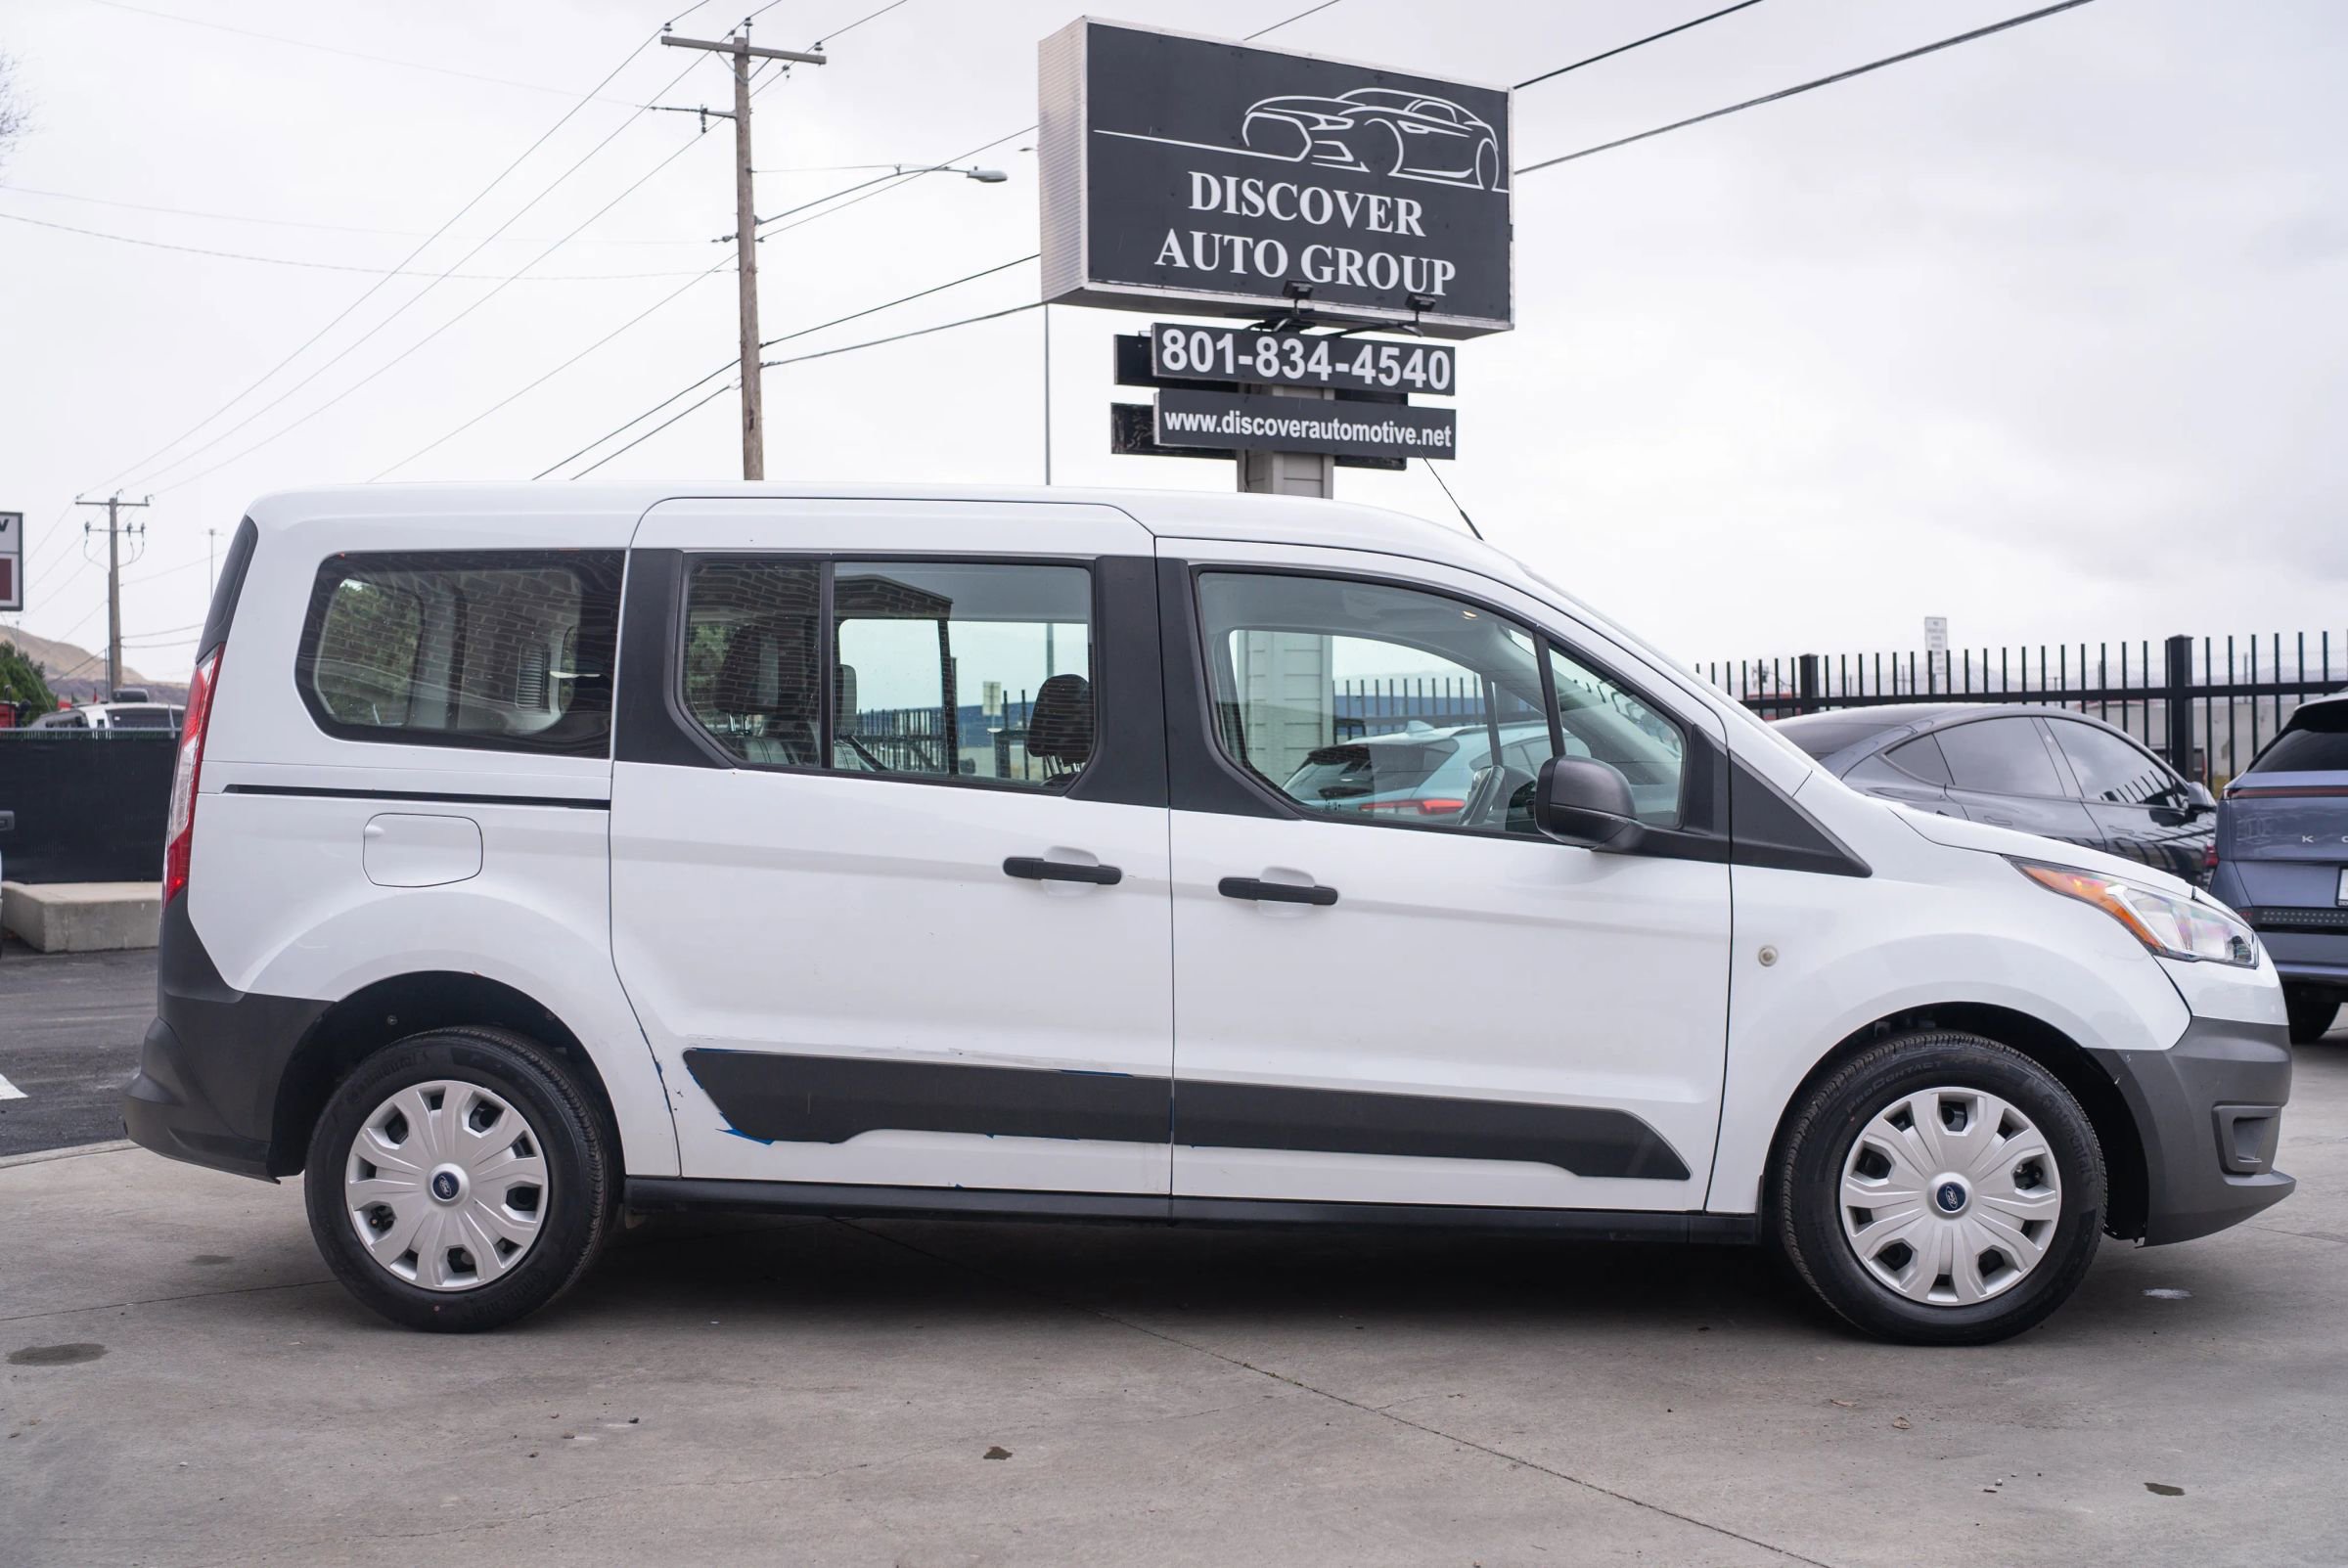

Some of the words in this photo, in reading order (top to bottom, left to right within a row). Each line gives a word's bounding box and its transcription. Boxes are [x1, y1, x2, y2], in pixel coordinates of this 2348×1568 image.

[1187, 170, 1427, 238] DISCOVER
[1153, 228, 1289, 279] AUTO
[1300, 244, 1457, 296] GROUP
[1161, 328, 1451, 390] 801-834-4540
[1164, 410, 1453, 448] www.discoverautomotive.net
